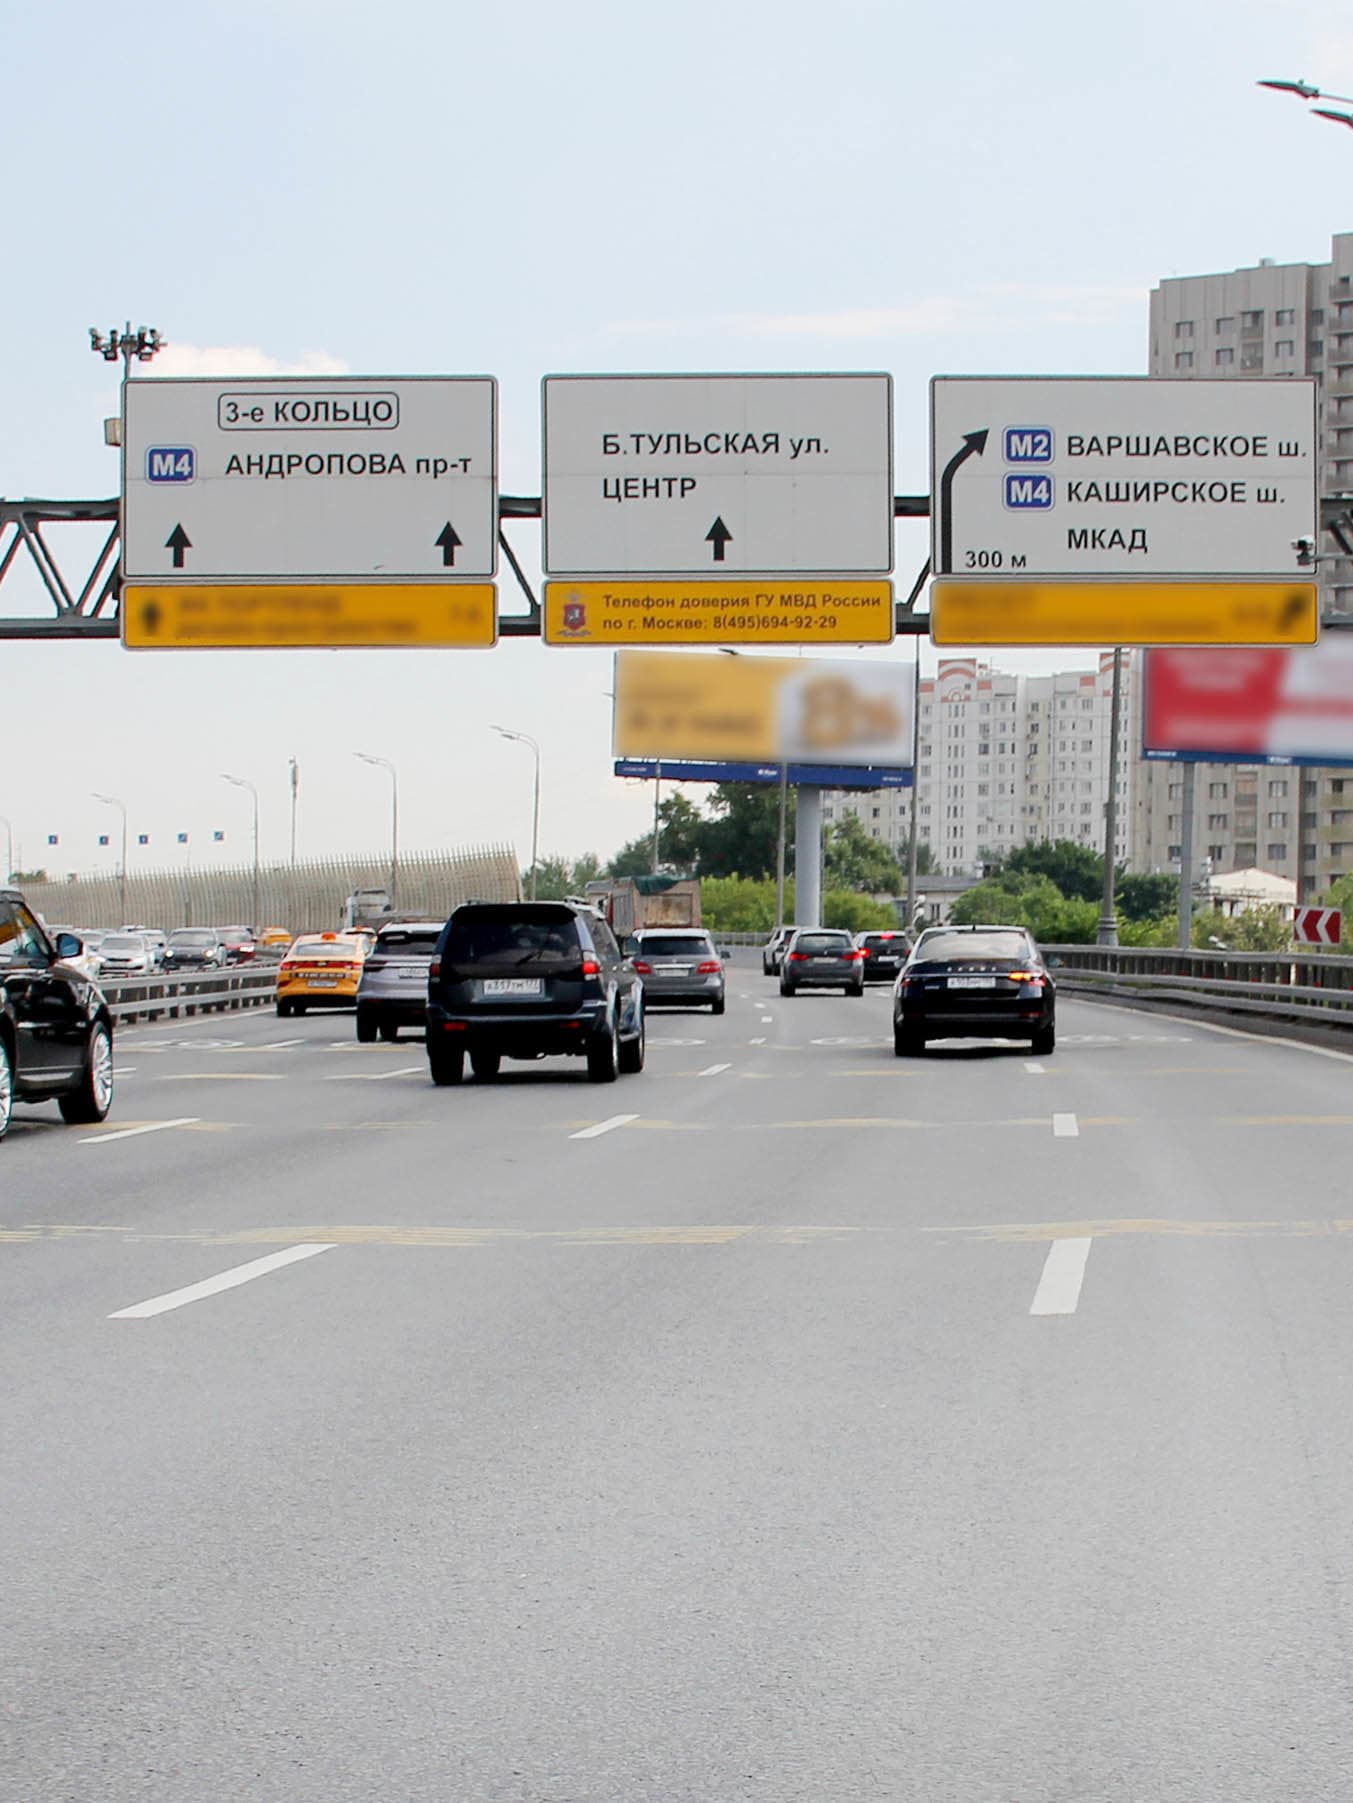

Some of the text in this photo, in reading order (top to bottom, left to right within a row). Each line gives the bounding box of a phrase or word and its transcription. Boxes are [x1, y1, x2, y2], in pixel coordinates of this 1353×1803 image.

[225, 401, 393, 425] 3-е КОЛЬЦО
[602, 433, 829, 459] Б.ТУЛЬСКАЯ ул.
[1010, 433, 1307, 457] М2 ВАРШАВСКОЕ ш.
[152, 453, 472, 479] М4 АНДРОПОВА пр-т
[602, 478, 697, 502] ЦЕНТР
[1010, 480, 1285, 503] М4 КАШИРСКОЕ ш.
[1067, 528, 1148, 553] МКАД
[965, 551, 1027, 568] 300 м
[603, 594, 881, 611] Телефон доверия ГУ МВД России
[603, 615, 837, 631] по г. Москве: 8(495)694-92-29
